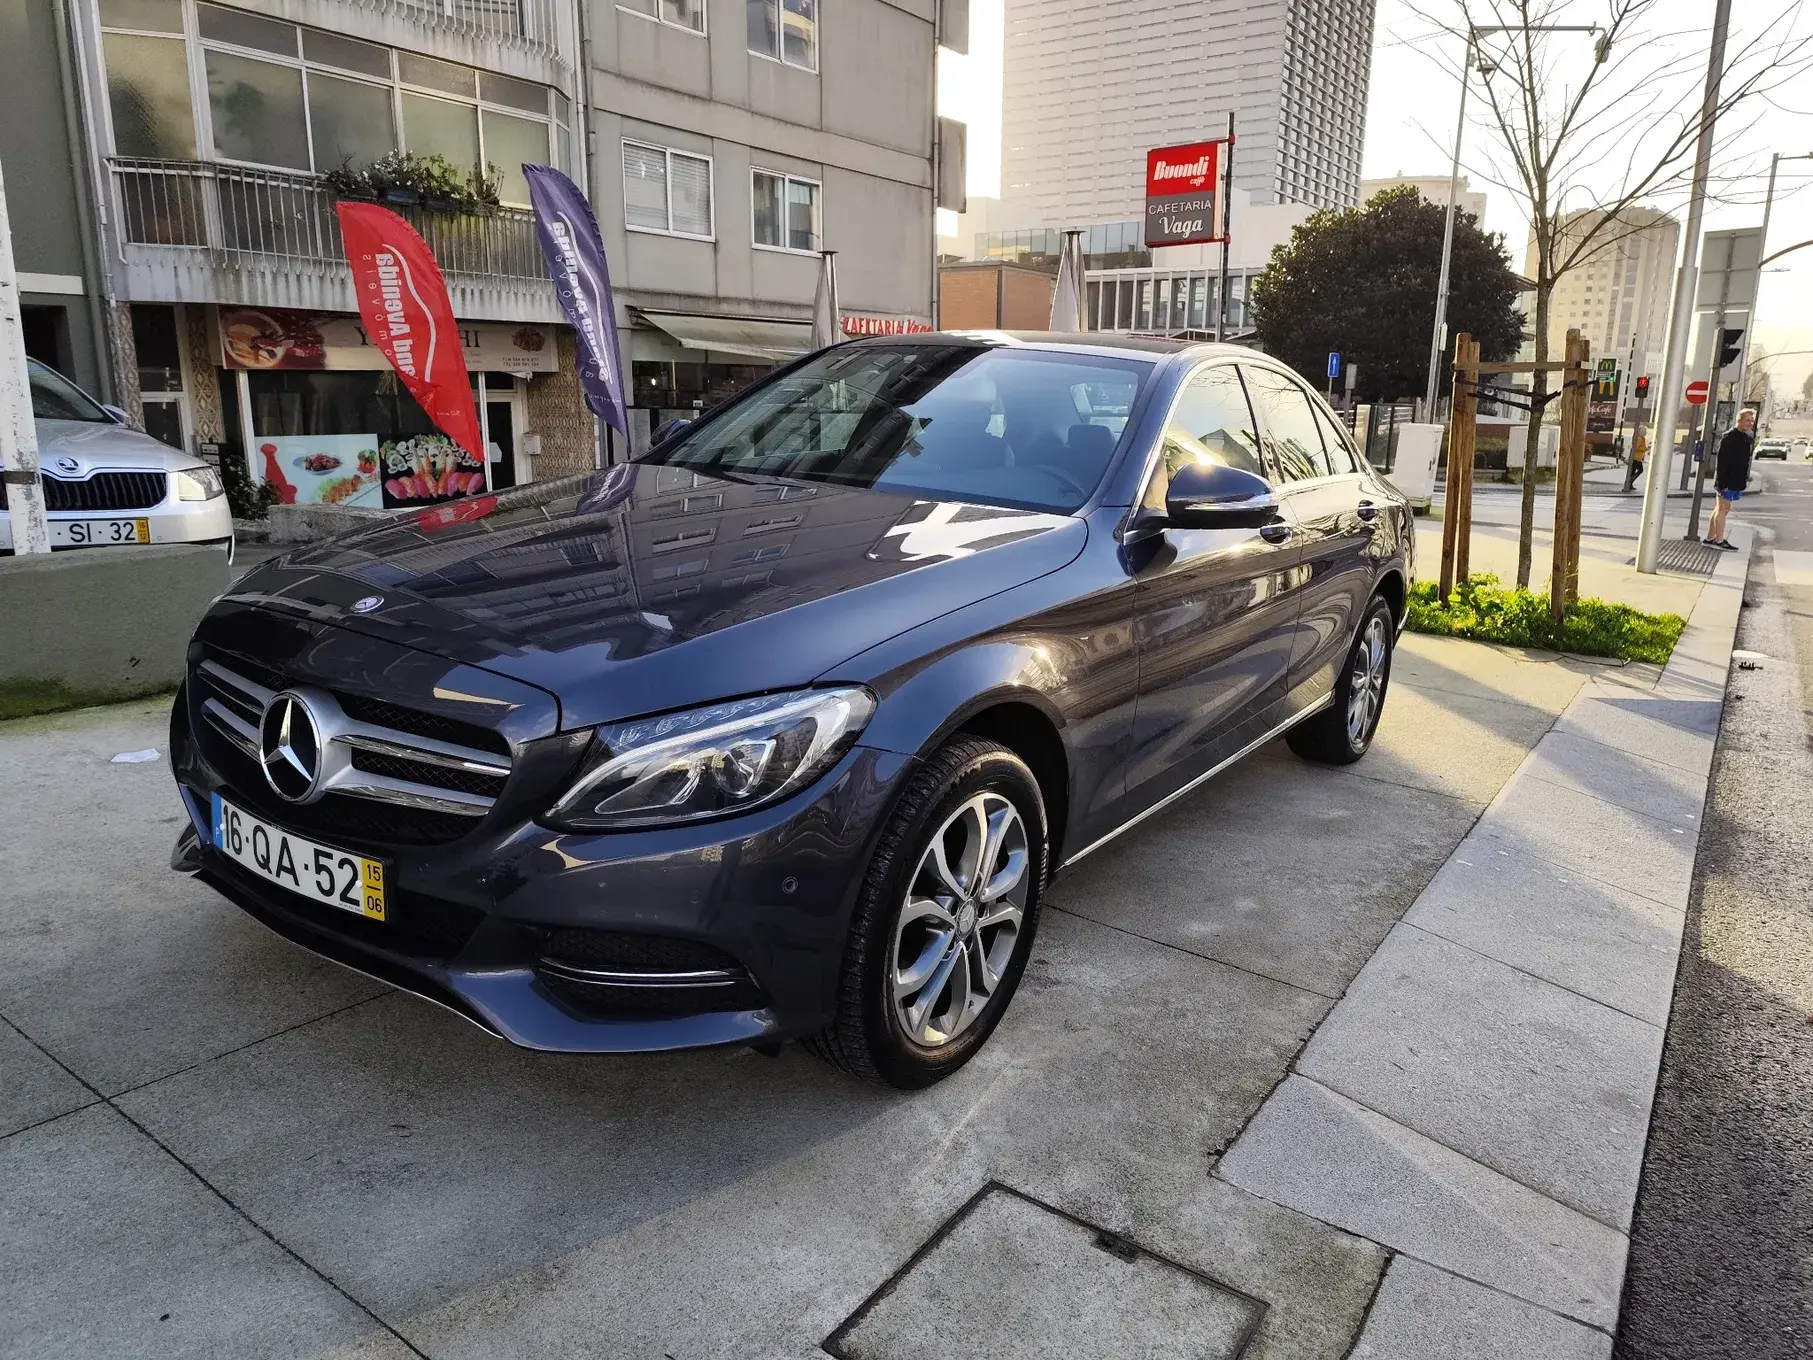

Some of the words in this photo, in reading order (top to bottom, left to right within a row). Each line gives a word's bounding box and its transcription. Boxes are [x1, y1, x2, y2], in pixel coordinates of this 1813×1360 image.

[1153, 155, 1210, 181] Buondi
[1148, 200, 1212, 215] CAFETARIA
[1159, 215, 1204, 239] Vaga
[366, 863, 382, 882] 15
[366, 895, 382, 913] 06
